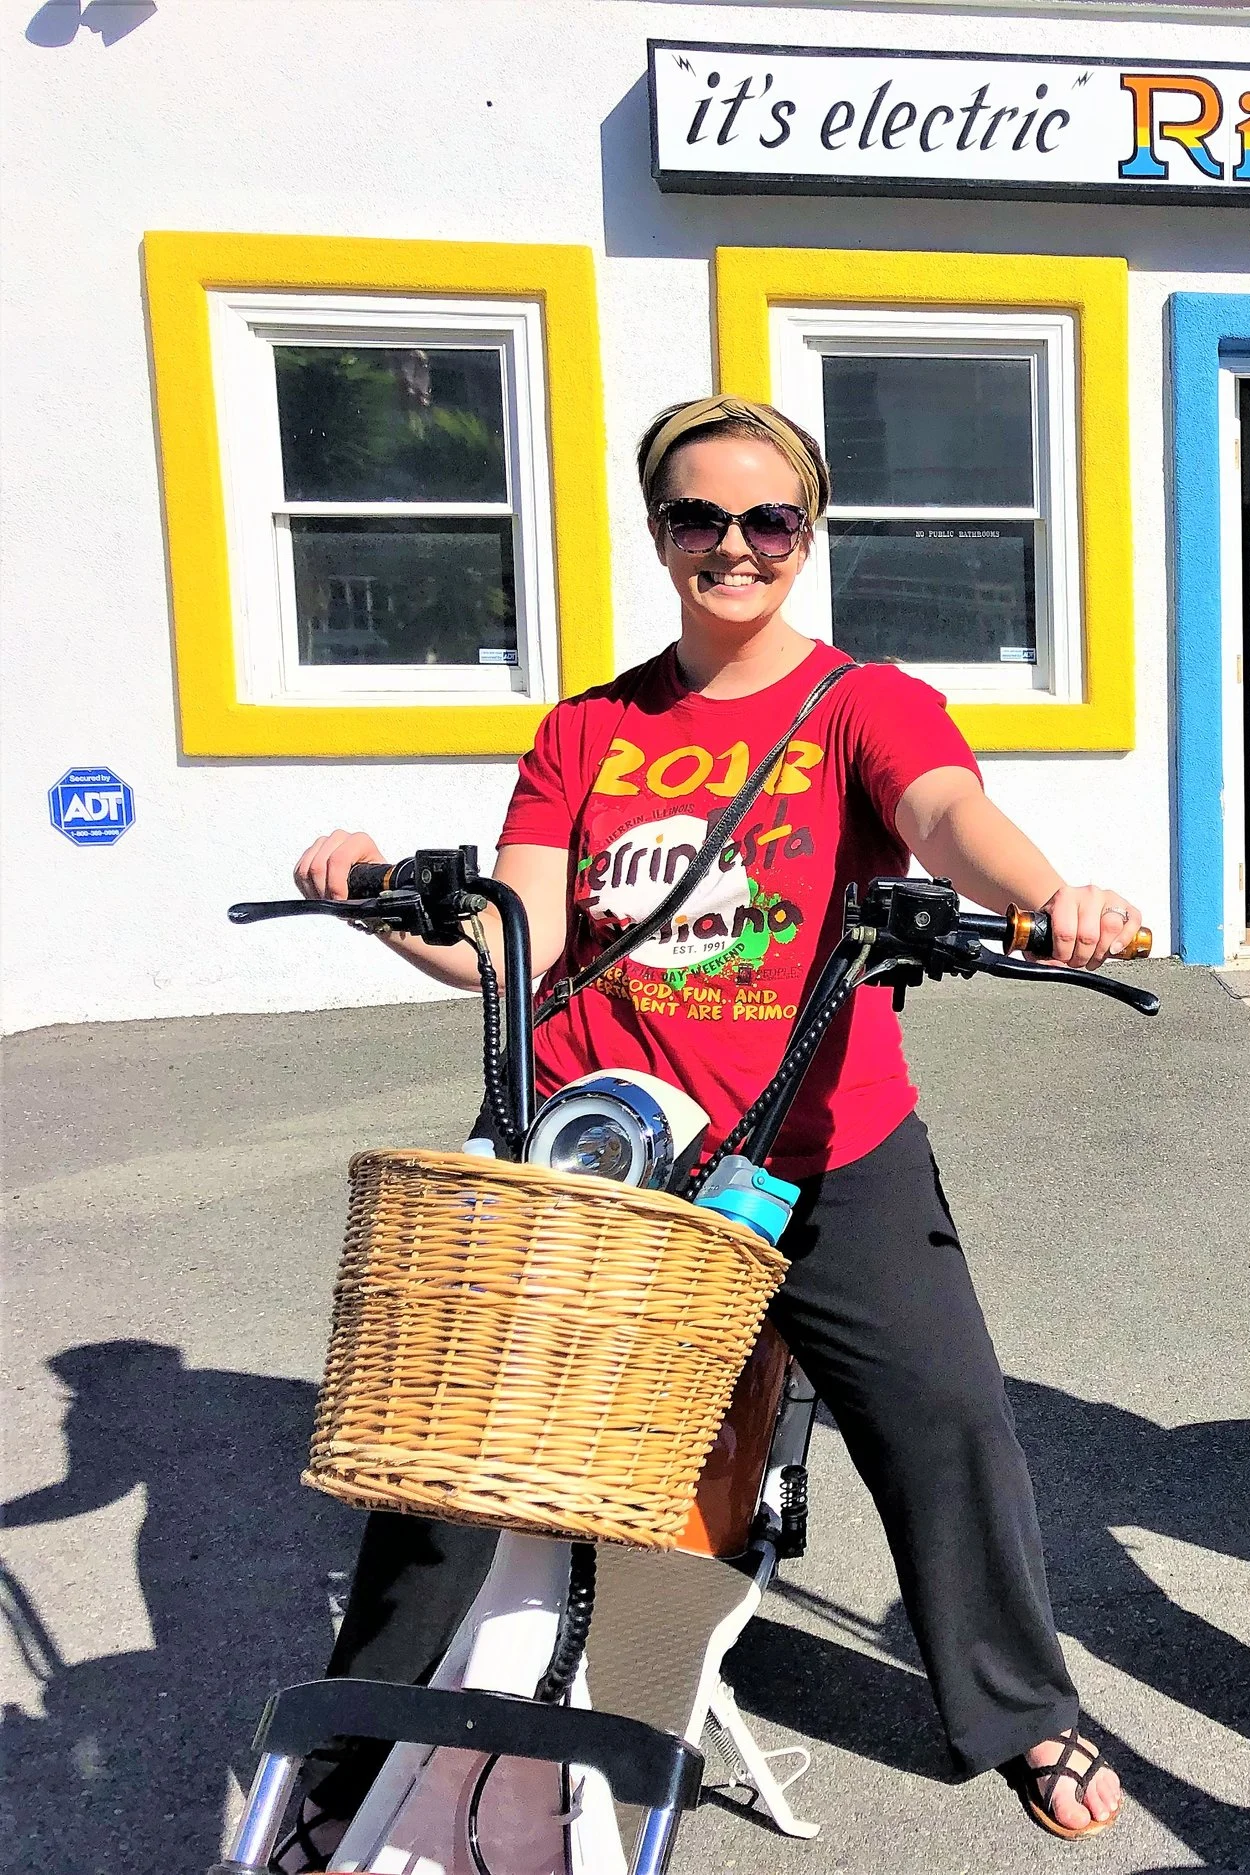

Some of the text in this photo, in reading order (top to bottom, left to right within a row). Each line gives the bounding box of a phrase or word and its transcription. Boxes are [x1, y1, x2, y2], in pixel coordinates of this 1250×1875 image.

[915, 530, 1000, 538] NO PUBLIC BATHROOMS
[592, 737, 825, 799] 2018
[70, 774, 111, 783] Secured by
[63, 790, 123, 822] ADT
[652, 803, 696, 820] ILLINOIS
[672, 940, 726, 955] EST. 1991
[662, 970, 685, 983] DAY
[690, 942, 746, 978] WEEKEND
[628, 979, 674, 1001] OOD,
[735, 988, 778, 1004] AND
[686, 1004, 723, 1020] ARE
[733, 1002, 798, 1021] PRIMO
